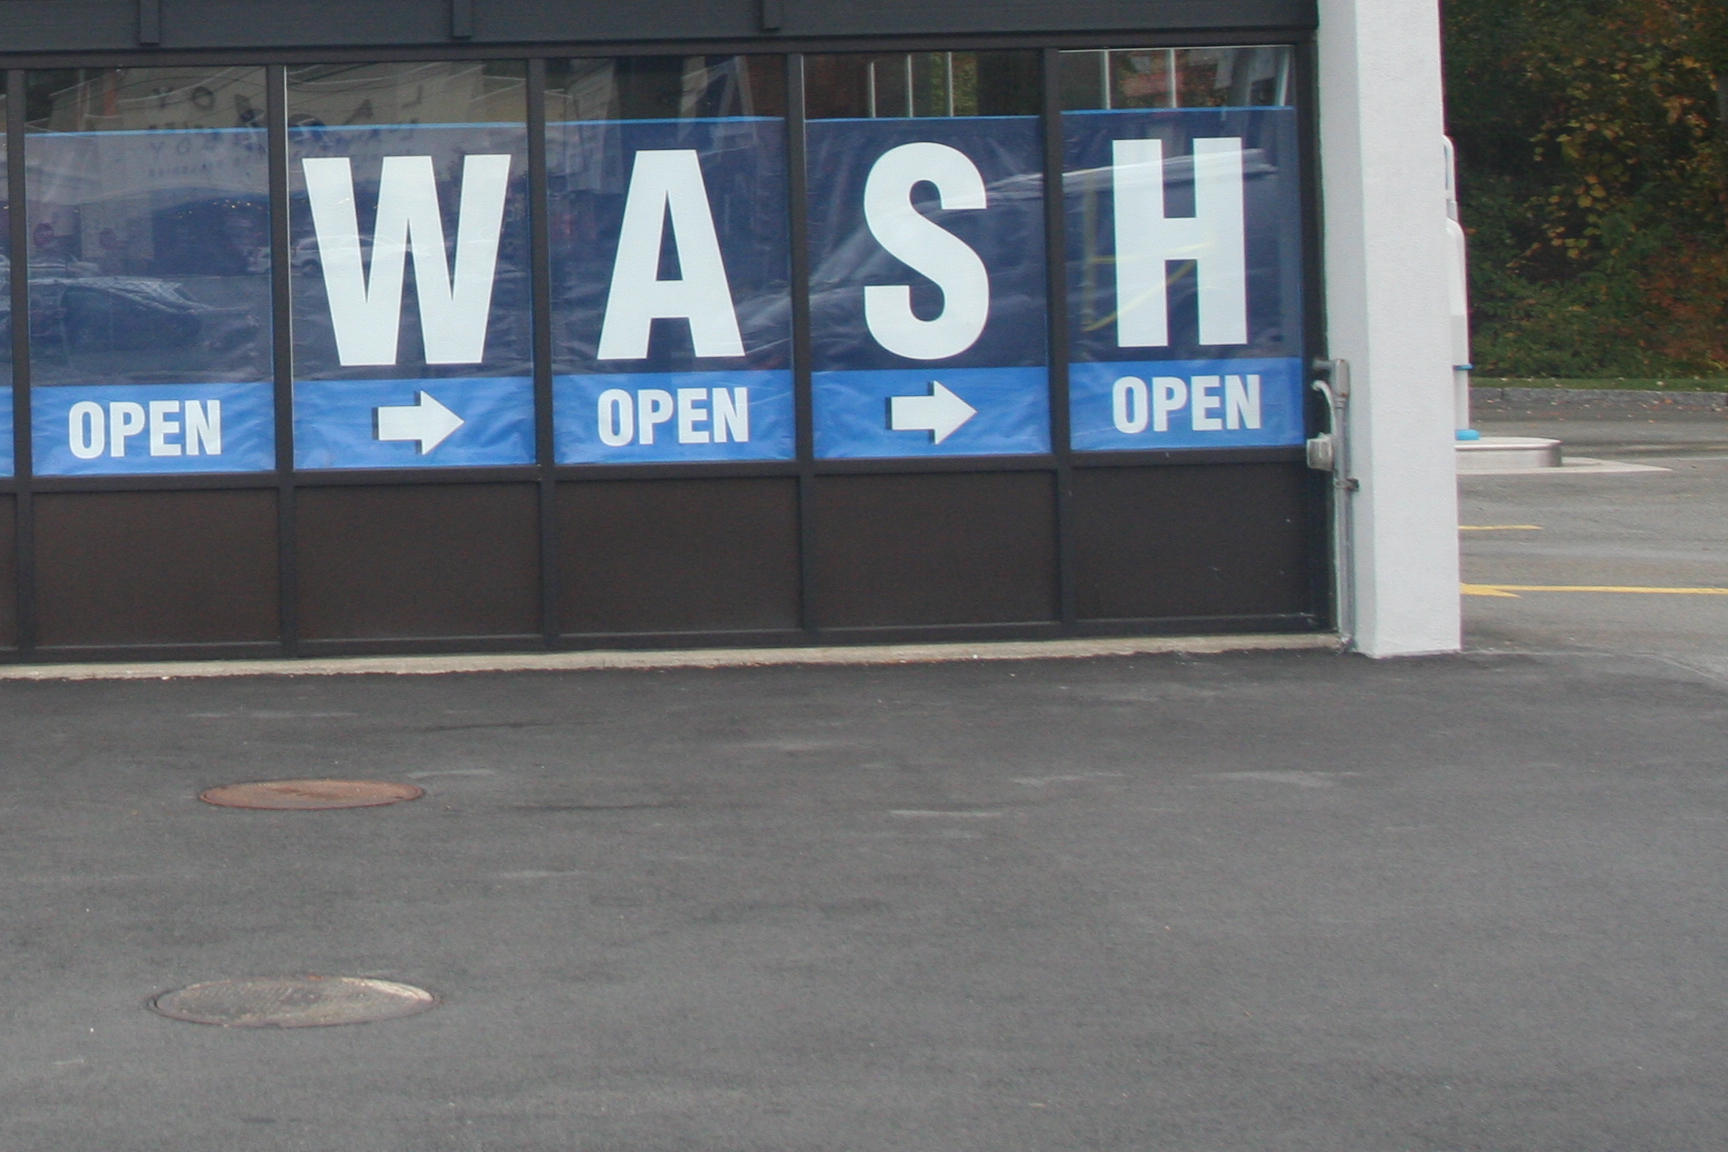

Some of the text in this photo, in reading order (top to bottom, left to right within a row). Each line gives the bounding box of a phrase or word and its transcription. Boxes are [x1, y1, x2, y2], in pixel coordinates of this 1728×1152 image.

[302, 137, 1248, 366] WASH
[69, 399, 222, 459] OPEN
[597, 386, 749, 447] OPEN
[1112, 373, 1262, 434] OPEN
